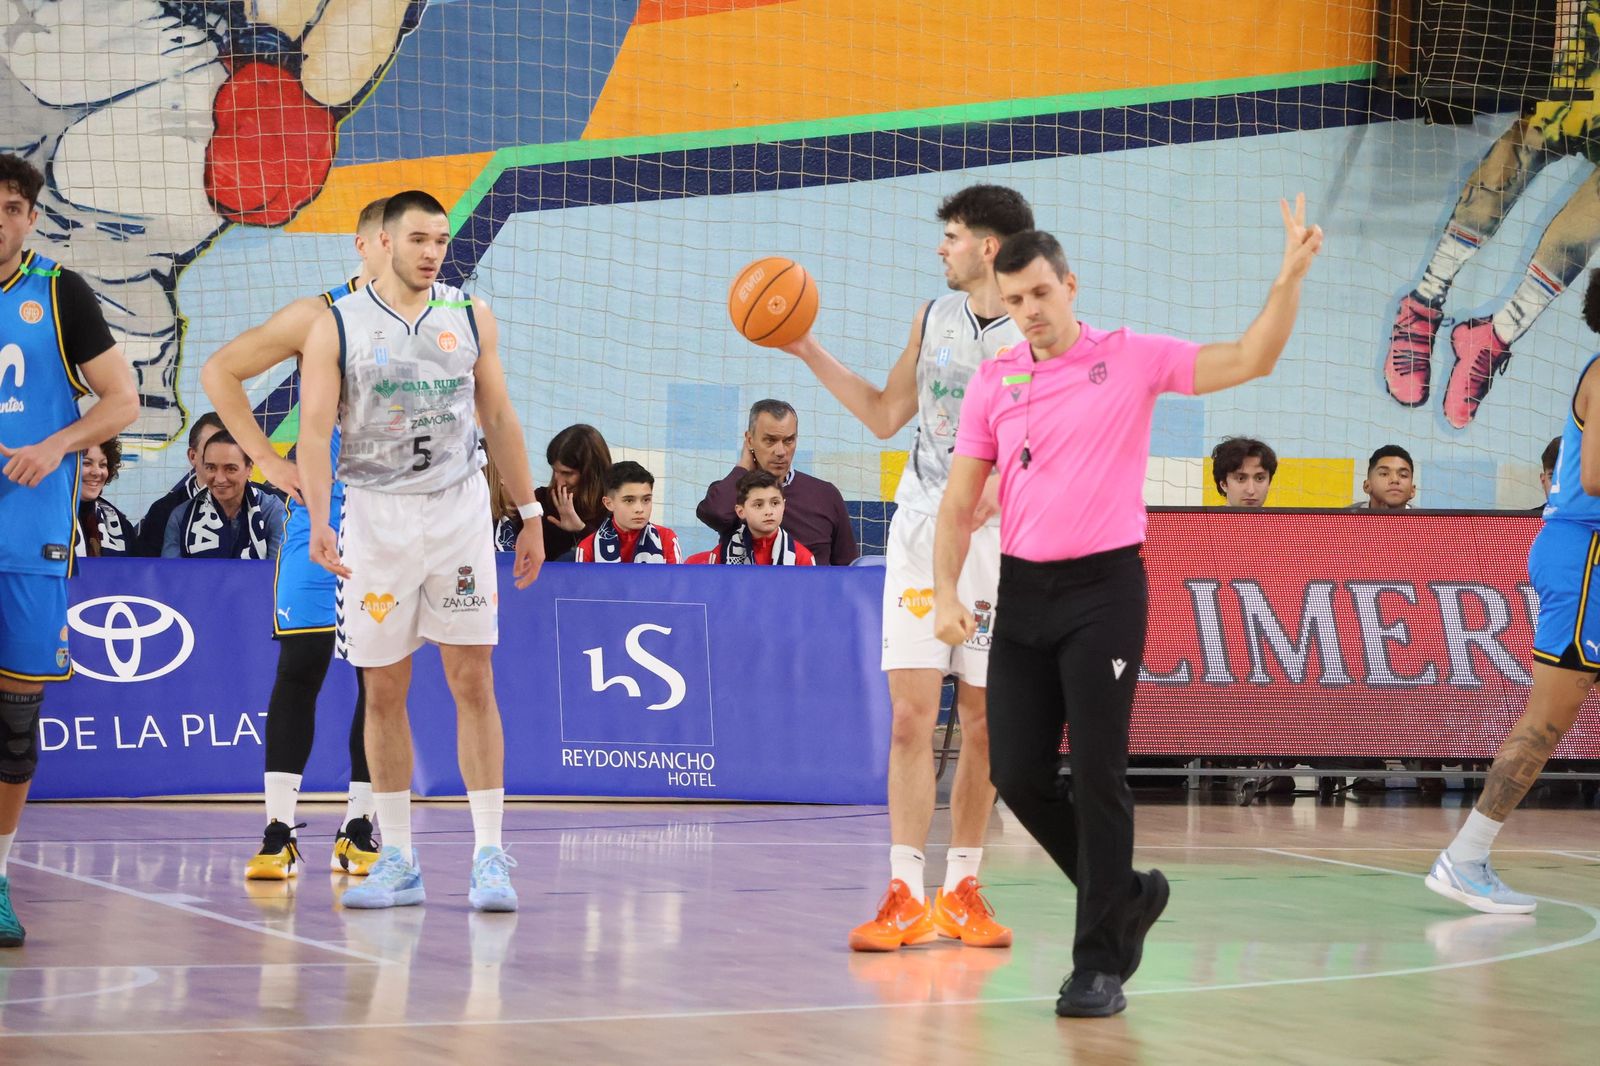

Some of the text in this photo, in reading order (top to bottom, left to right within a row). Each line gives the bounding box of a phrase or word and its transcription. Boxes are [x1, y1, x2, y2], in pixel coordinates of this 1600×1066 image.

[410, 412, 457, 430] ZAMORA
[411, 435, 432, 471] 5
[442, 595, 488, 609] ZAMORA
[38, 716, 98, 751] DE
[113, 714, 168, 749] LA
[562, 748, 715, 770] REYDONSANCHO
[668, 772, 716, 787] HOTEL
